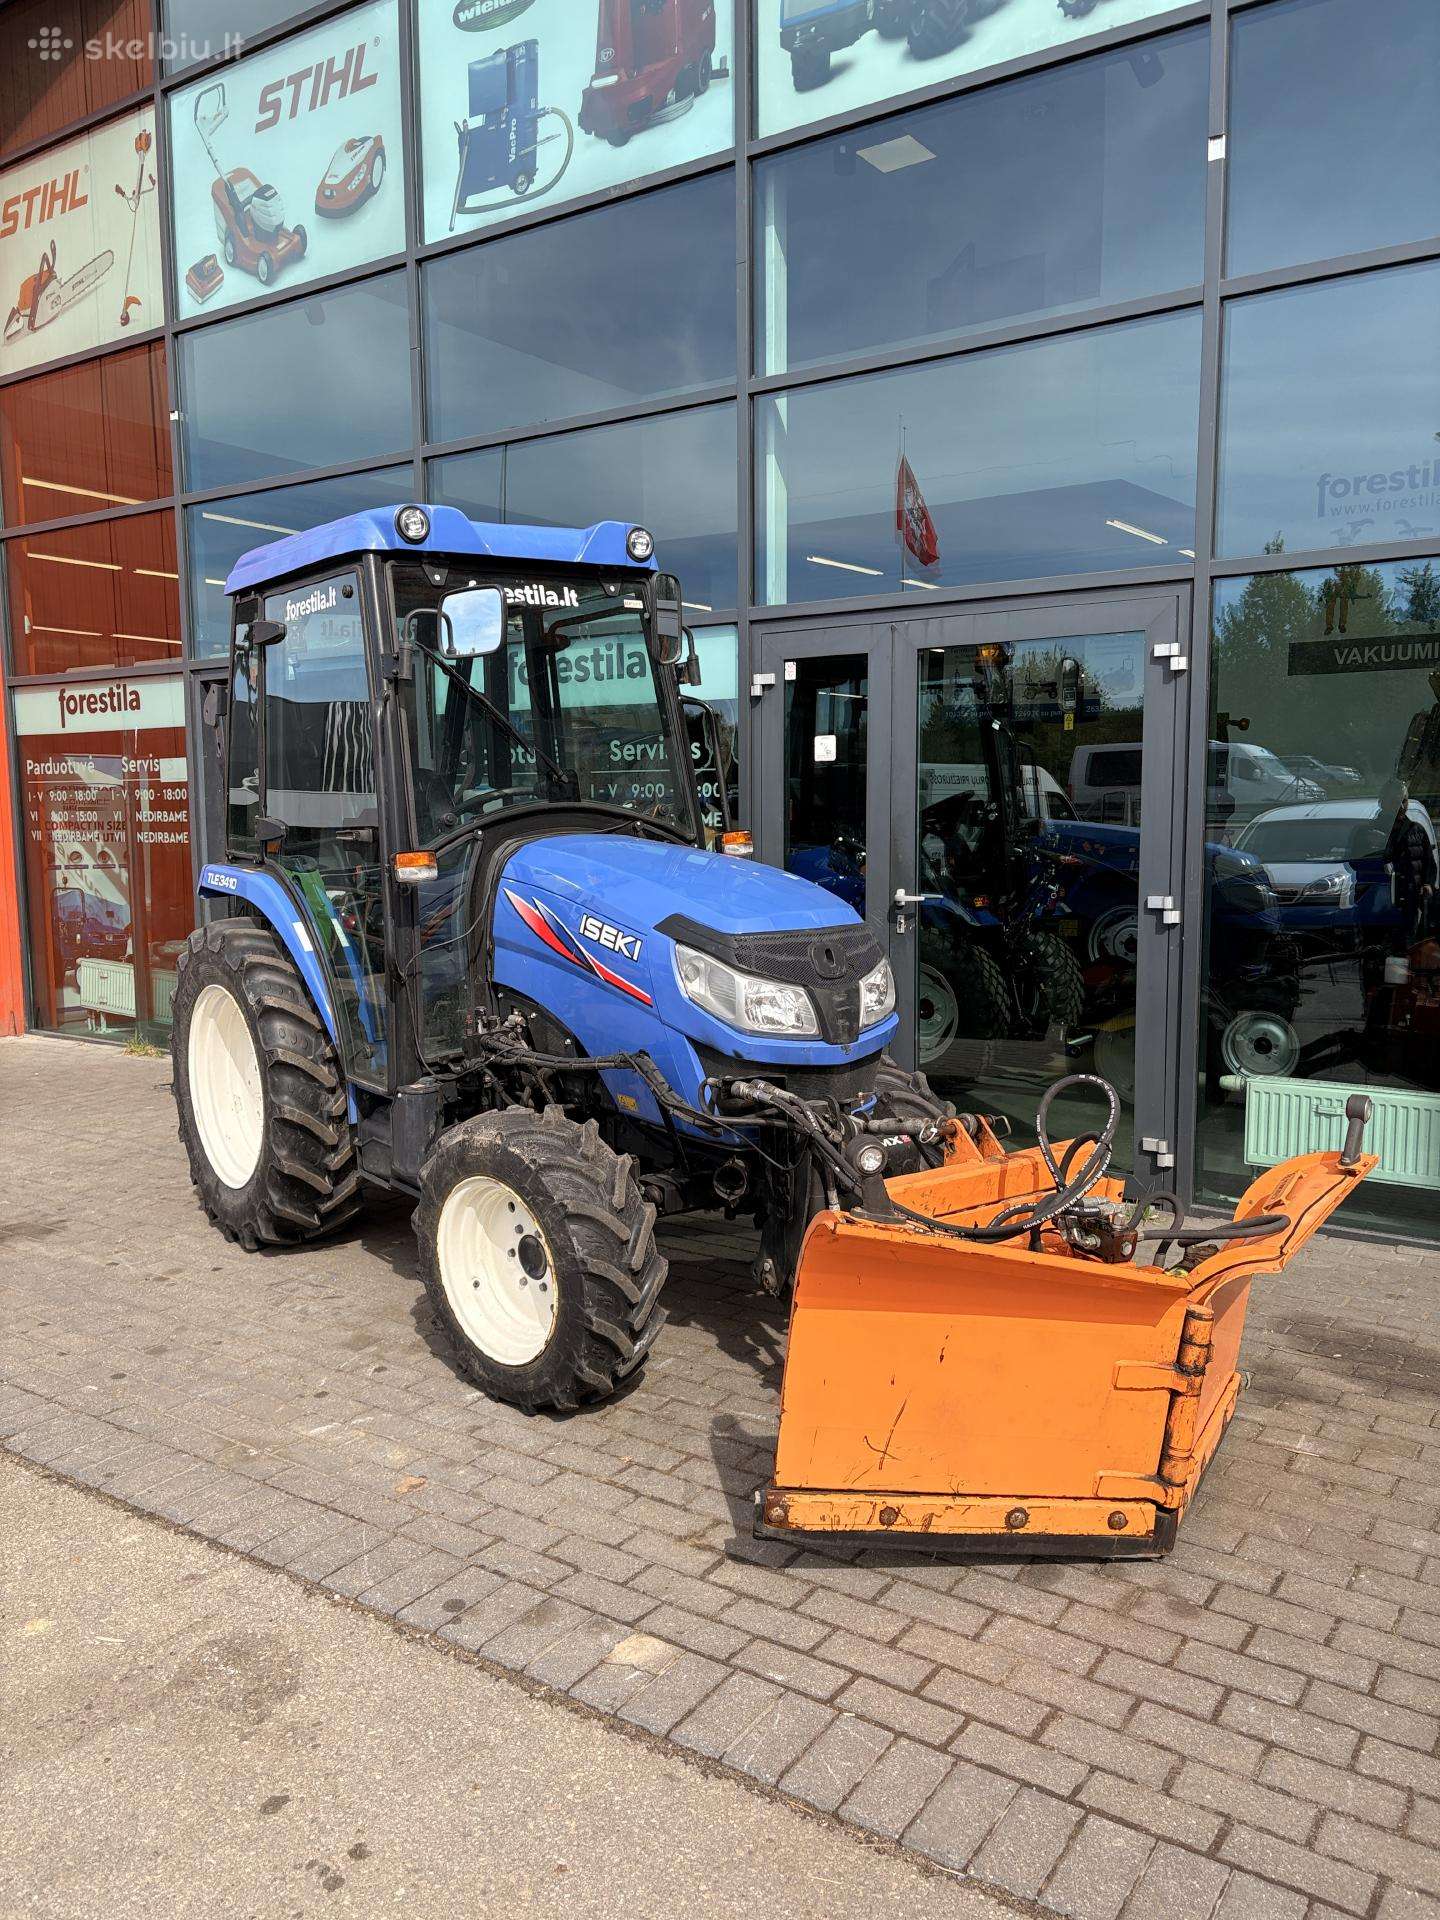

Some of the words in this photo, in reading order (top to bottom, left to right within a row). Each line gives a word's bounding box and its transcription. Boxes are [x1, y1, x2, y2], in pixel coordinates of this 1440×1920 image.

[255, 42, 379, 134] STIHL
[508, 117, 517, 164] VacPro
[0, 168, 89, 240] STIHL
[285, 586, 337, 622] forestila.lt
[508, 642, 647, 707] foestila
[58, 683, 141, 728] forestila
[49, 791, 67, 801] 9:00
[75, 790, 97, 801] 18:00
[135, 789, 154, 801] 9:00
[162, 788, 187, 800] 18:00
[631, 783, 665, 798] 9:00
[30, 811, 38, 821] VI
[76, 811, 98, 821] 15:00
[113, 811, 122, 821] VI
[136, 811, 188, 822] NEDIRBAME
[46, 821, 92, 831] COMPACT
[94, 821, 105, 831] IN
[107, 820, 126, 830] SIZE
[31, 830, 42, 840] VII
[115, 832, 126, 842] VII
[137, 832, 189, 843] NEDIRBAME
[207, 872, 238, 890] TLE3410
[579, 913, 643, 962] ISEKI
